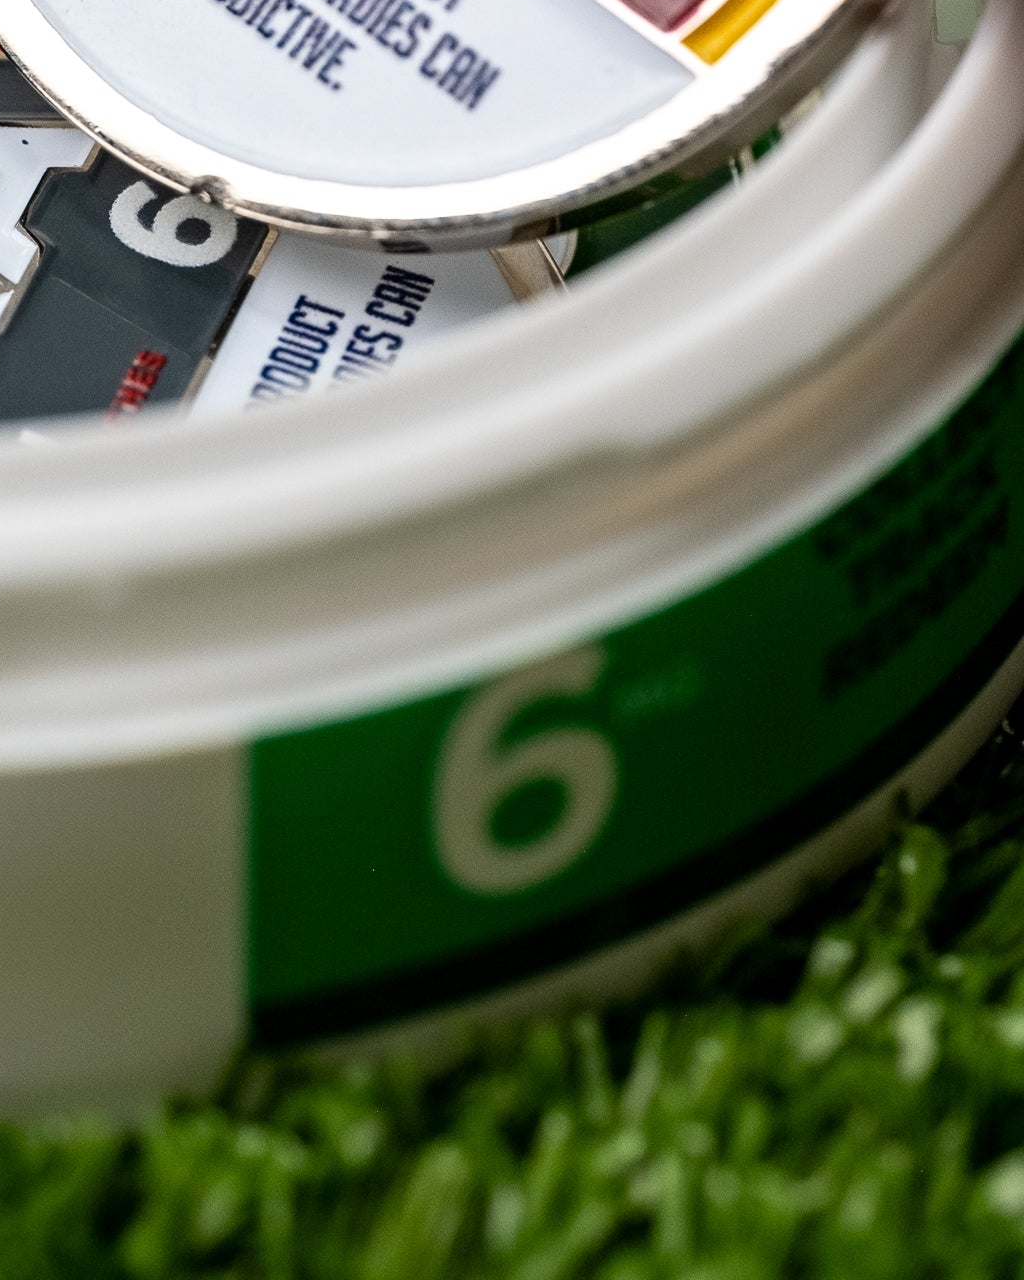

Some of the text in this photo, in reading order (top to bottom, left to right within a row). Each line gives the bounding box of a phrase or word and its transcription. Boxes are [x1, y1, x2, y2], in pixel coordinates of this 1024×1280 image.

[419, 31, 501, 111] CAN
[109, 178, 238, 268] 6
[364, 264, 436, 328] CAN
[429, 637, 619, 898] 6
